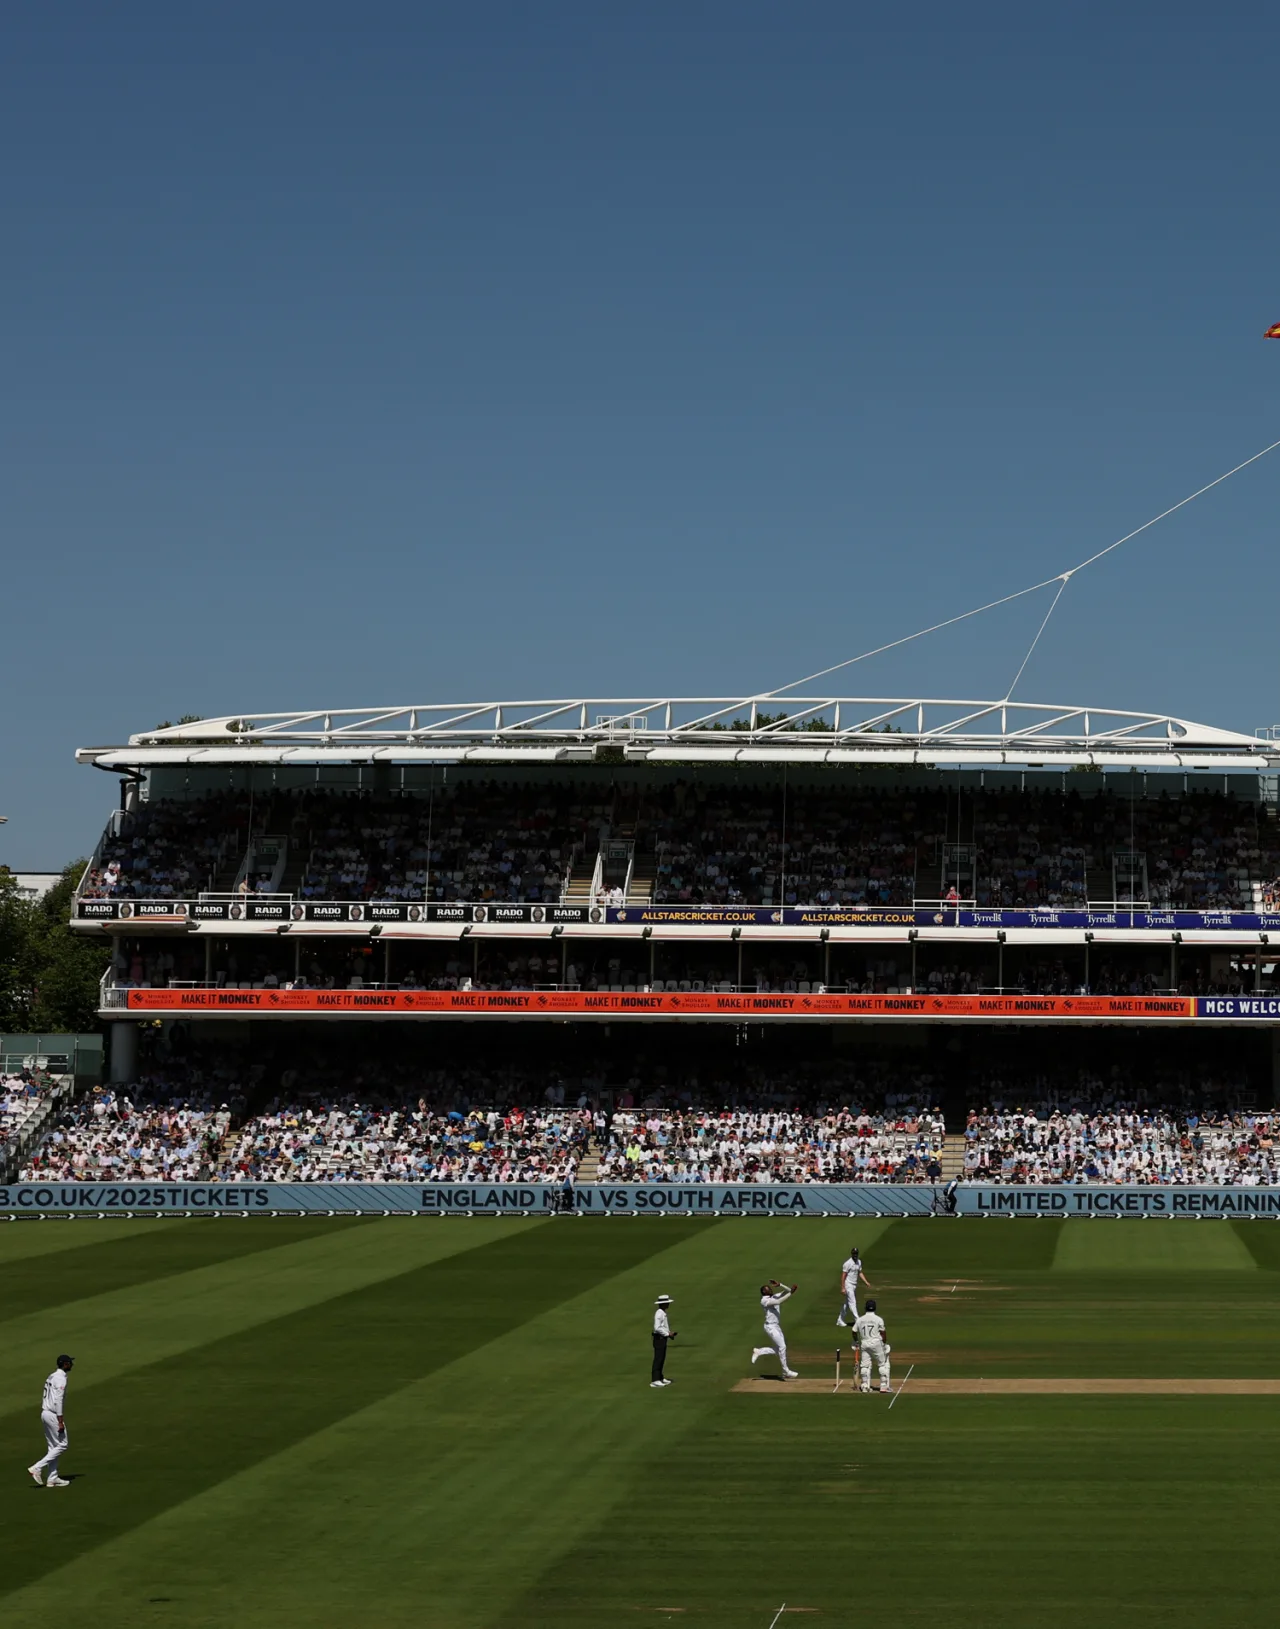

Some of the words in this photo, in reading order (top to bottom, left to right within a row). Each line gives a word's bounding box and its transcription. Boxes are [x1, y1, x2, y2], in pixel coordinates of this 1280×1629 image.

[140, 905, 168, 913] RADO
[641, 911, 755, 921] ALLSTARSCRICKET.CO.UK
[801, 913, 915, 922] ALLSTARSCRICKET.CO.UK
[181, 994, 206, 1004] MAKE
[208, 994, 217, 1004] IT
[219, 994, 261, 1004] MONKEY
[317, 995, 341, 1005] MAKE
[344, 995, 352, 1005] IT
[354, 995, 396, 1005] MONKEY
[452, 996, 475, 1006] MAKE
[478, 996, 486, 1006] IT
[488, 996, 529, 1006] MONKEY
[585, 997, 609, 1007] MAKE
[612, 997, 619, 1007] IT
[621, 997, 662, 1007] MONKEY
[717, 998, 741, 1008] MAKE
[743, 999, 751, 1008] IT
[753, 999, 794, 1009] MONKEY
[849, 1000, 872, 1009] MAKE
[875, 1000, 882, 1009] IT
[884, 1000, 925, 1010] MONKEY
[980, 1001, 1002, 1010] MAKE
[1005, 1001, 1013, 1010] IT
[1015, 1001, 1055, 1011] MONKEY
[1109, 1001, 1132, 1011] MAKE
[1135, 1002, 1142, 1011] IT
[1144, 1002, 1185, 1012] MONKEY
[1206, 1001, 1234, 1013] MCC
[421, 1190, 536, 1207] ENGLAND
[542, 1190, 592, 1208] MN
[599, 1190, 629, 1208] VS
[634, 1191, 714, 1208] SOUTH
[719, 1191, 807, 1209] AFRICA
[977, 1192, 1067, 1210] LIMITED
[1072, 1193, 1166, 1211] TICKETS
[862, 1325, 875, 1338] 17
